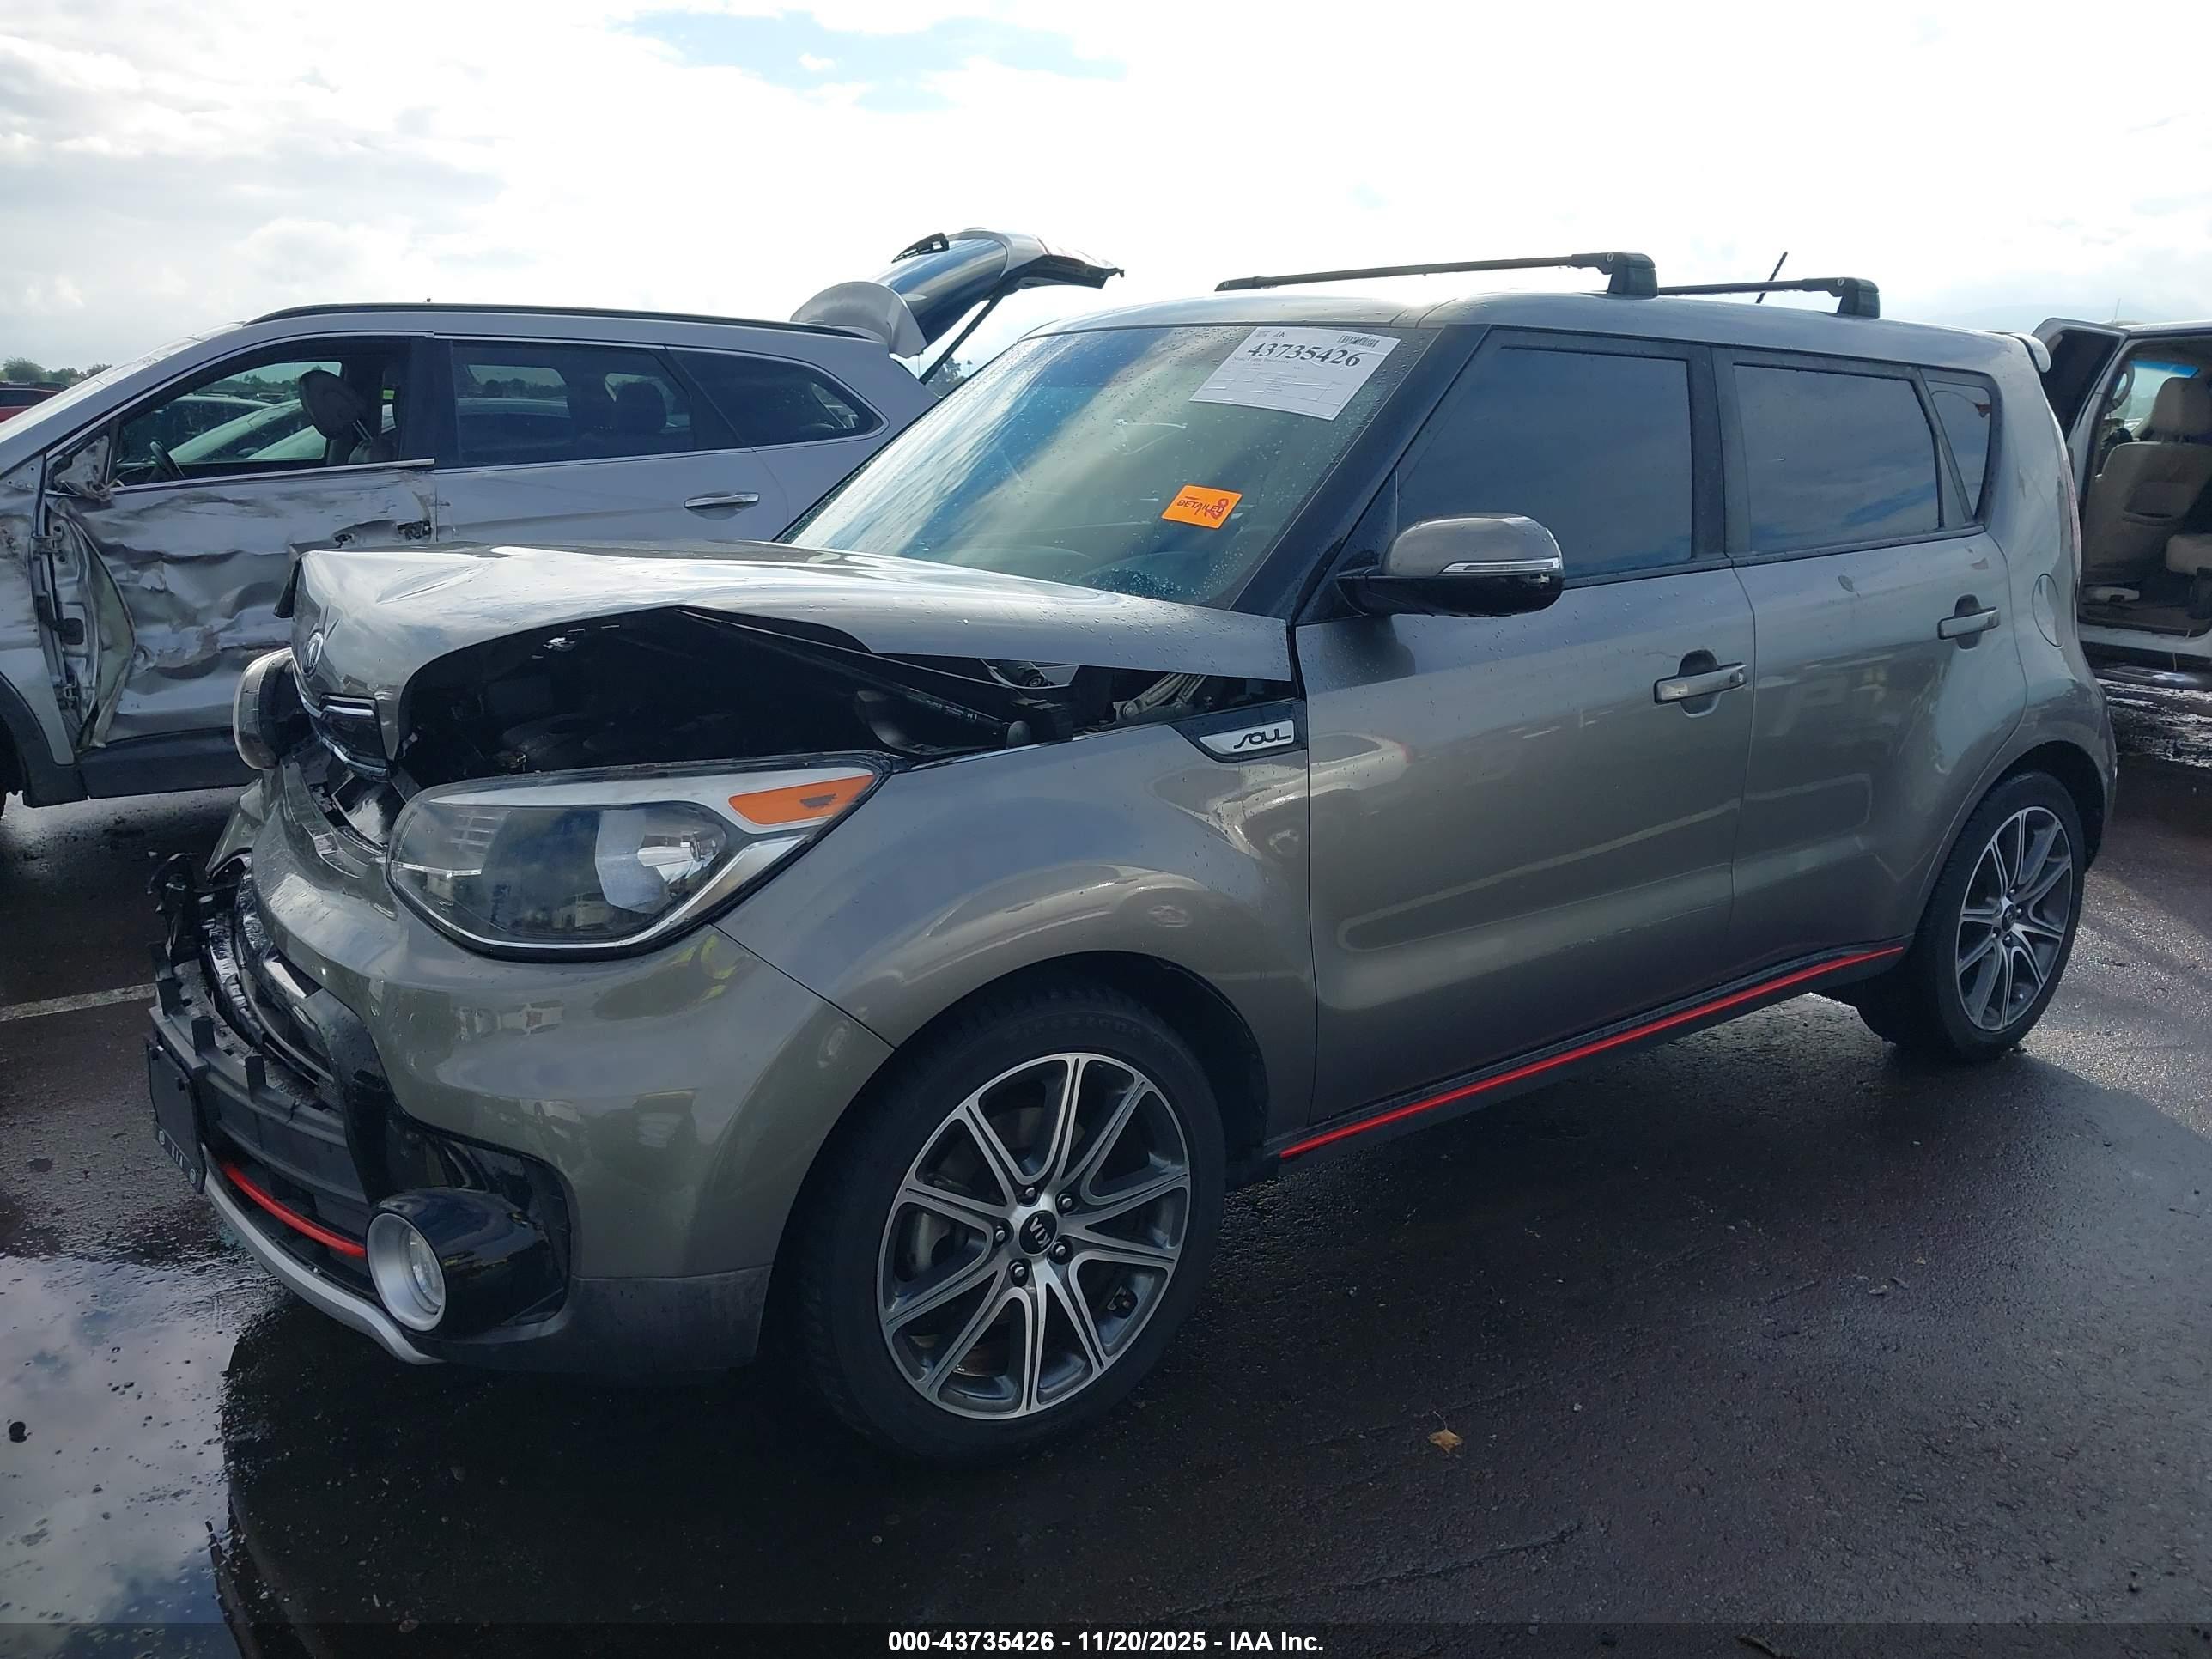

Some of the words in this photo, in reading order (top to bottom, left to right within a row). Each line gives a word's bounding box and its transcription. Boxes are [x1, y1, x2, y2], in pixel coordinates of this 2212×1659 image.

[1248, 343, 1368, 367] 43735426
[1176, 500, 1225, 514] DETAILED
[1233, 728, 1291, 750] SOUL
